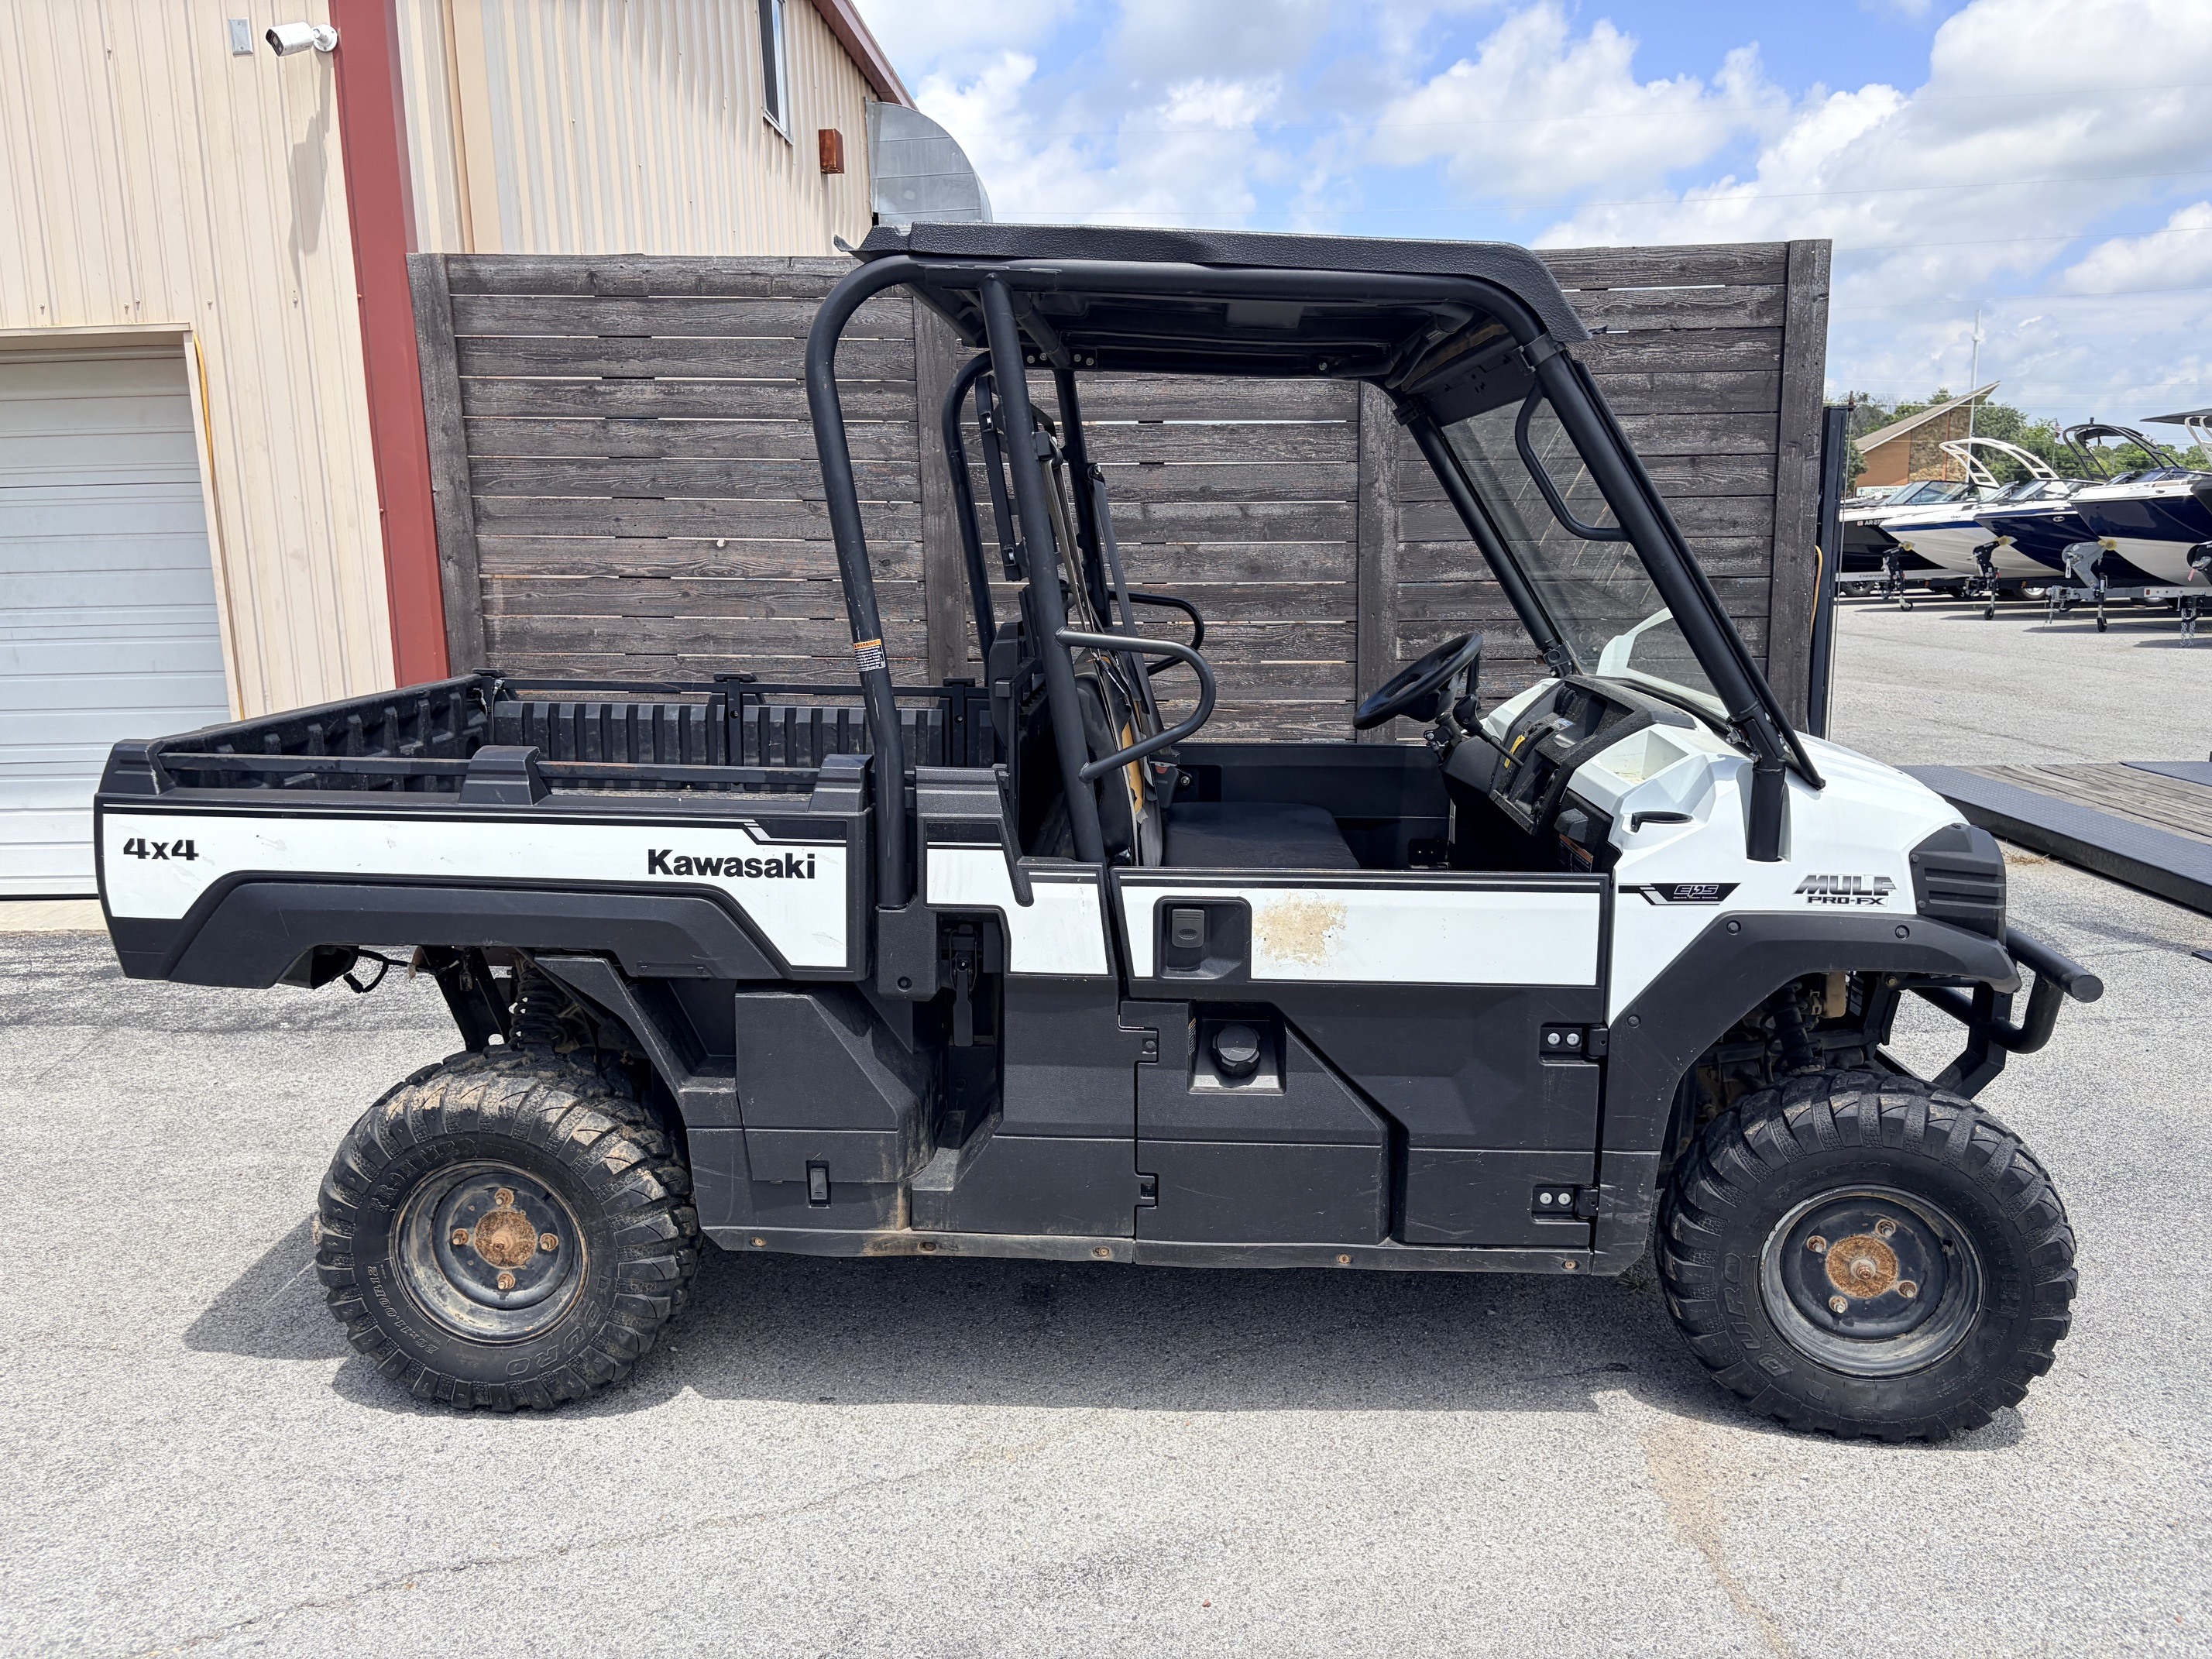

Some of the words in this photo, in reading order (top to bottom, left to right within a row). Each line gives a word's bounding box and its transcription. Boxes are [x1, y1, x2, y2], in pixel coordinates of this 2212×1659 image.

[123, 838, 199, 860] 4x4
[647, 849, 816, 879] Kawasaki
[1674, 884, 1719, 897] EPS
[1807, 897, 1887, 905] PRO-FX
